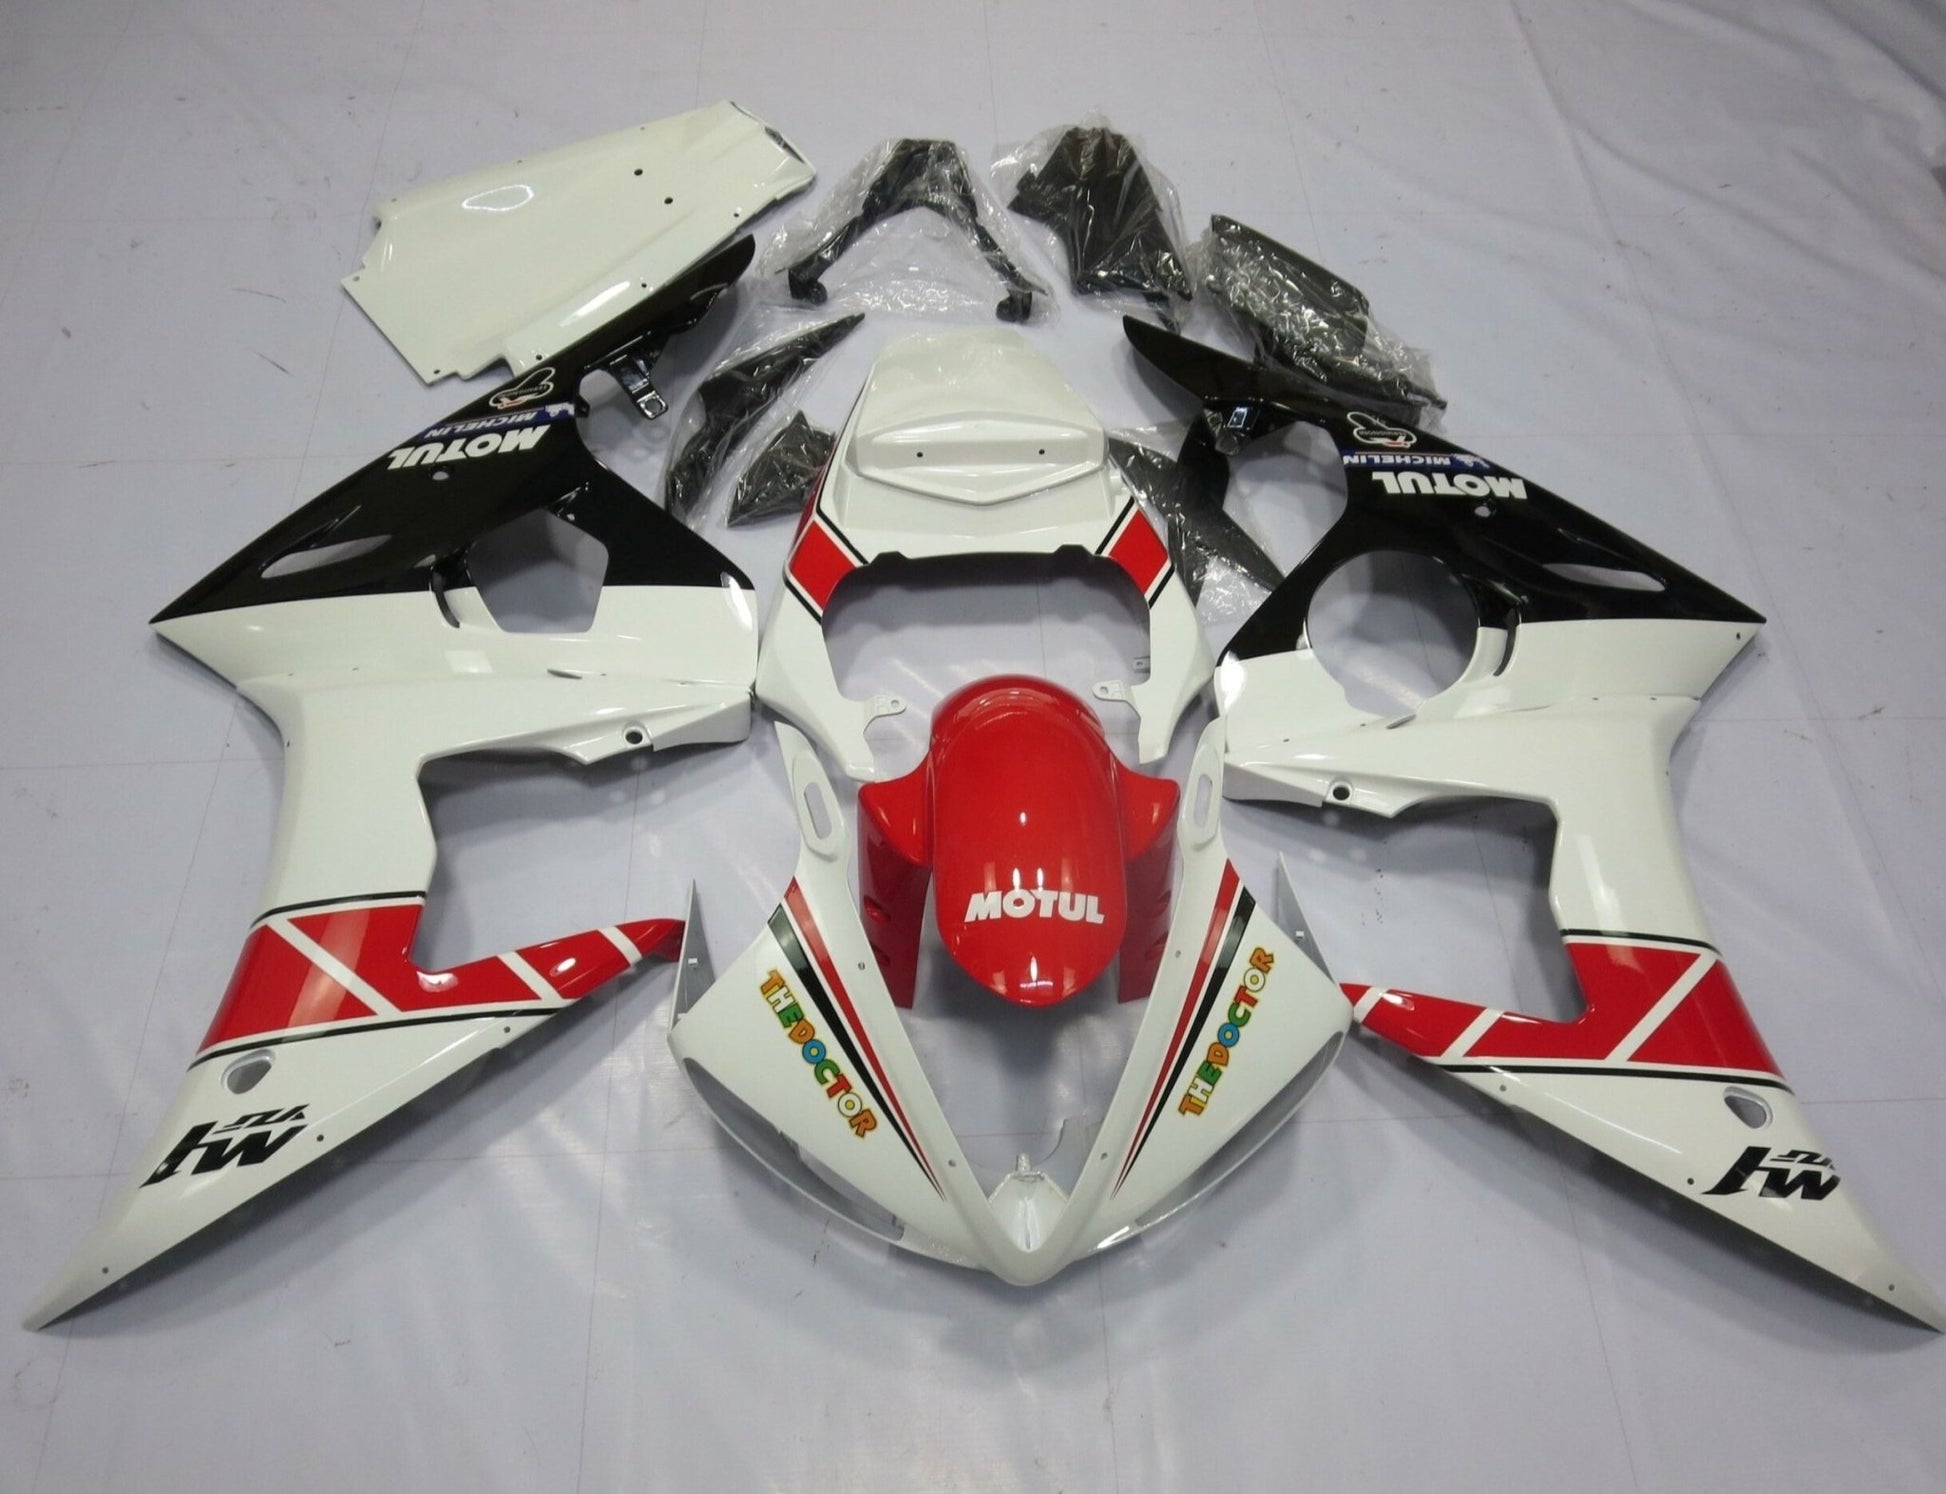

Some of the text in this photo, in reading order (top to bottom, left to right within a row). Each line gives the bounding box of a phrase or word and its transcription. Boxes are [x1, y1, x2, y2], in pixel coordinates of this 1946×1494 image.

[424, 411, 539, 438] MICHELIN
[386, 424, 551, 470] MOTUL
[1342, 454, 1451, 466] MICHELIN
[1372, 471, 1528, 500] MOTUL
[964, 889, 1105, 924] MOTUL
